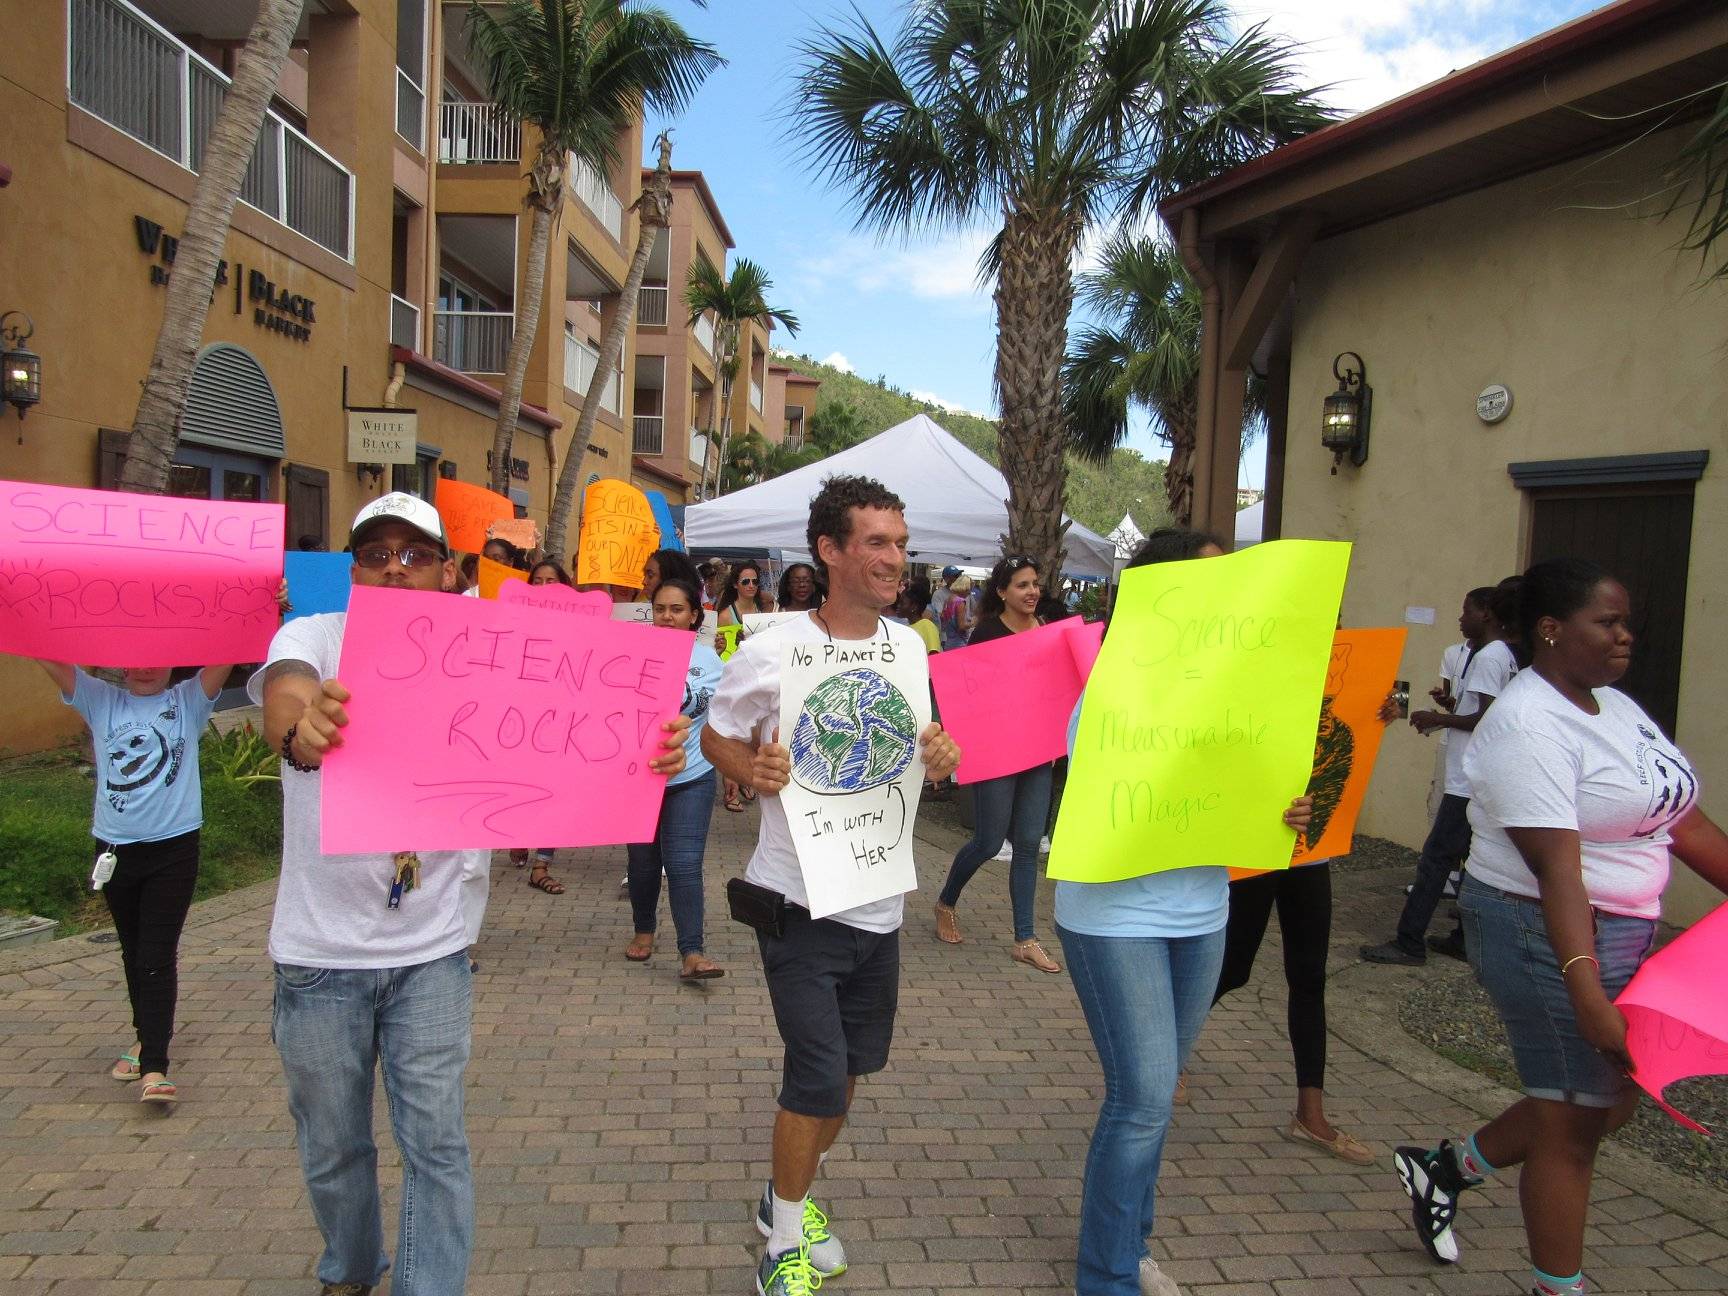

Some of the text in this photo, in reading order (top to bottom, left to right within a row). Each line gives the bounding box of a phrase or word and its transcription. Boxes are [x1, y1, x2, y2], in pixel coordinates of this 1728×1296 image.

[249, 268, 316, 324] BLACK
[361, 419, 405, 432] WHITE
[362, 438, 401, 450] BLACK
[10, 492, 277, 550] SCIENCE
[609, 540, 647, 573] DNA
[1133, 586, 1277, 668] Science
[377, 616, 666, 700] SCIENCE
[791, 644, 813, 668] No
[448, 701, 660, 777] ROCKS!
[1100, 708, 1268, 753] Measurable
[844, 809, 884, 832] WITH
[1111, 778, 1221, 834] Magic
[850, 838, 887, 870] HER
